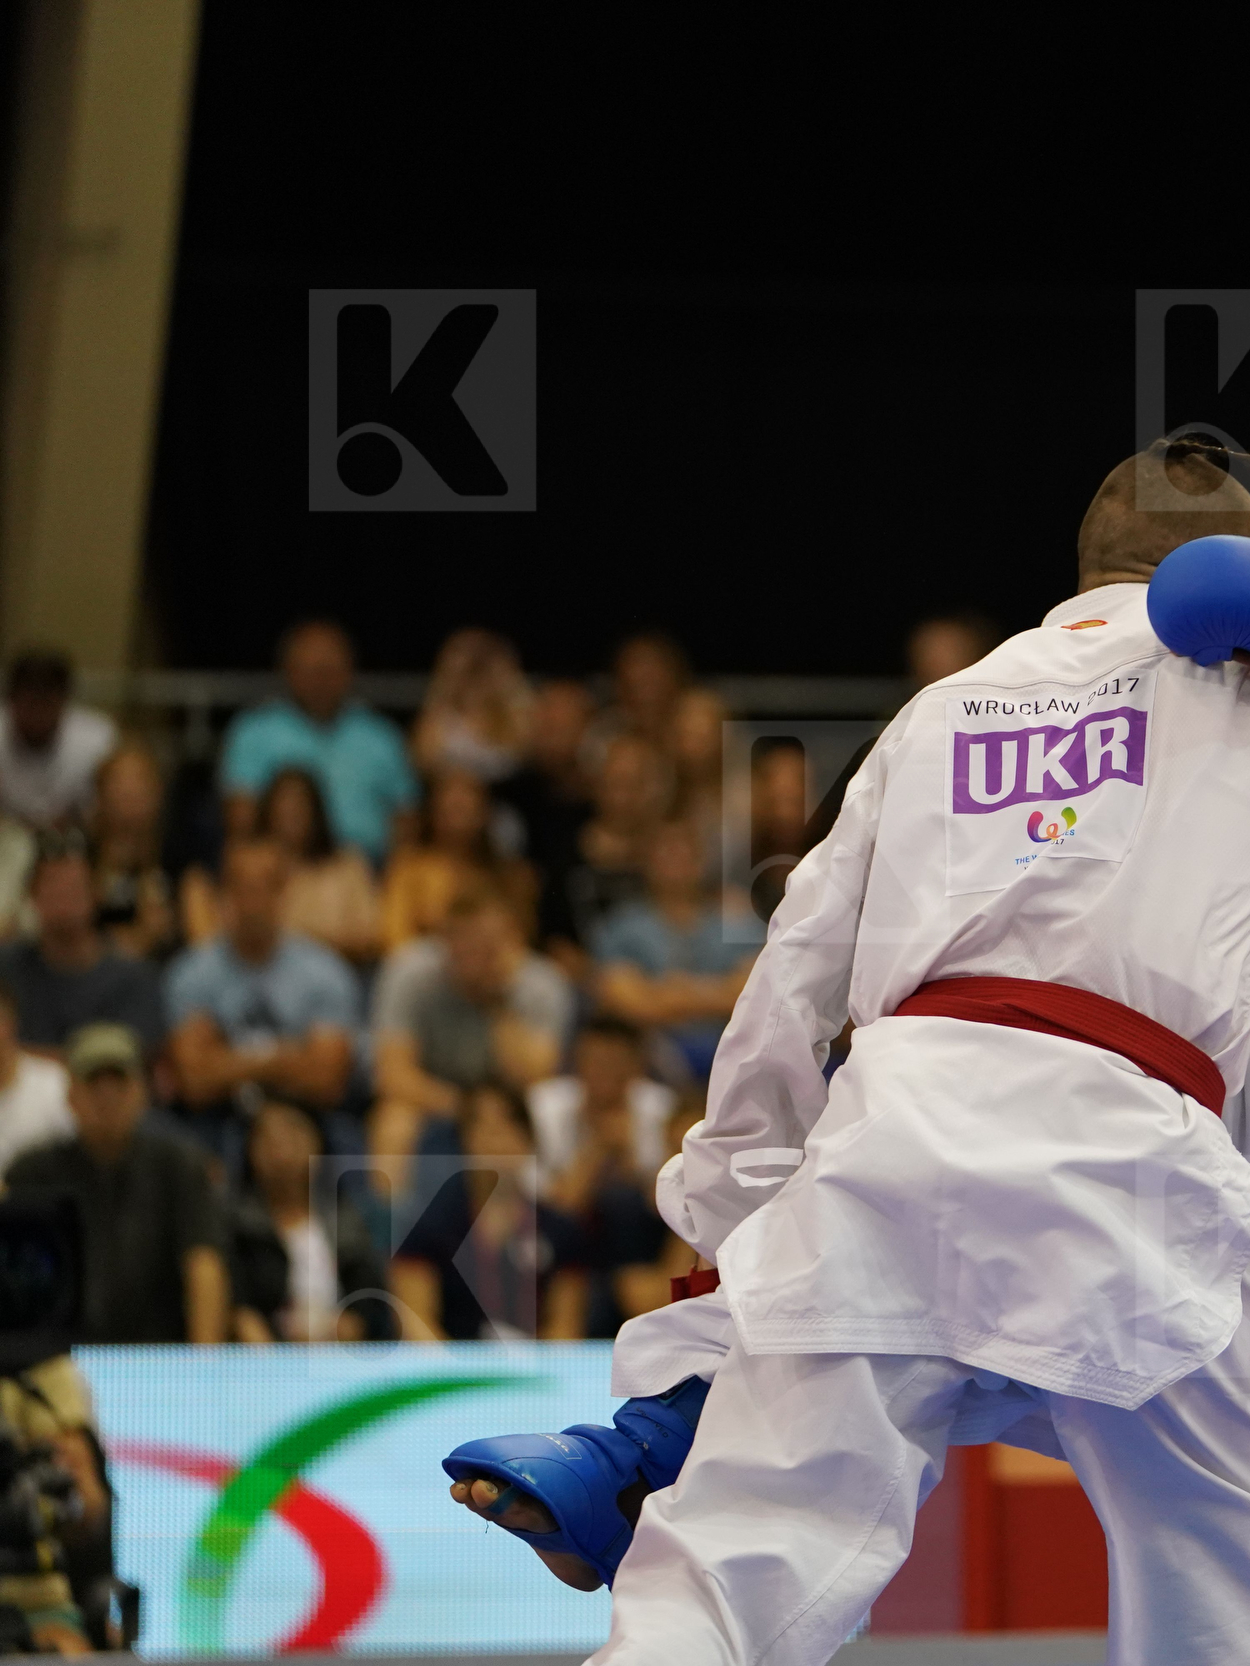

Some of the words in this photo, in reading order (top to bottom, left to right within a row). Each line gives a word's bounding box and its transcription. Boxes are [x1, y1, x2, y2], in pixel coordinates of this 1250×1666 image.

[963, 698, 1080, 716] WROCŁAW
[1087, 677, 1140, 707] 2017
[968, 716, 1130, 805] UKR
[1014, 855, 1031, 866] THE
